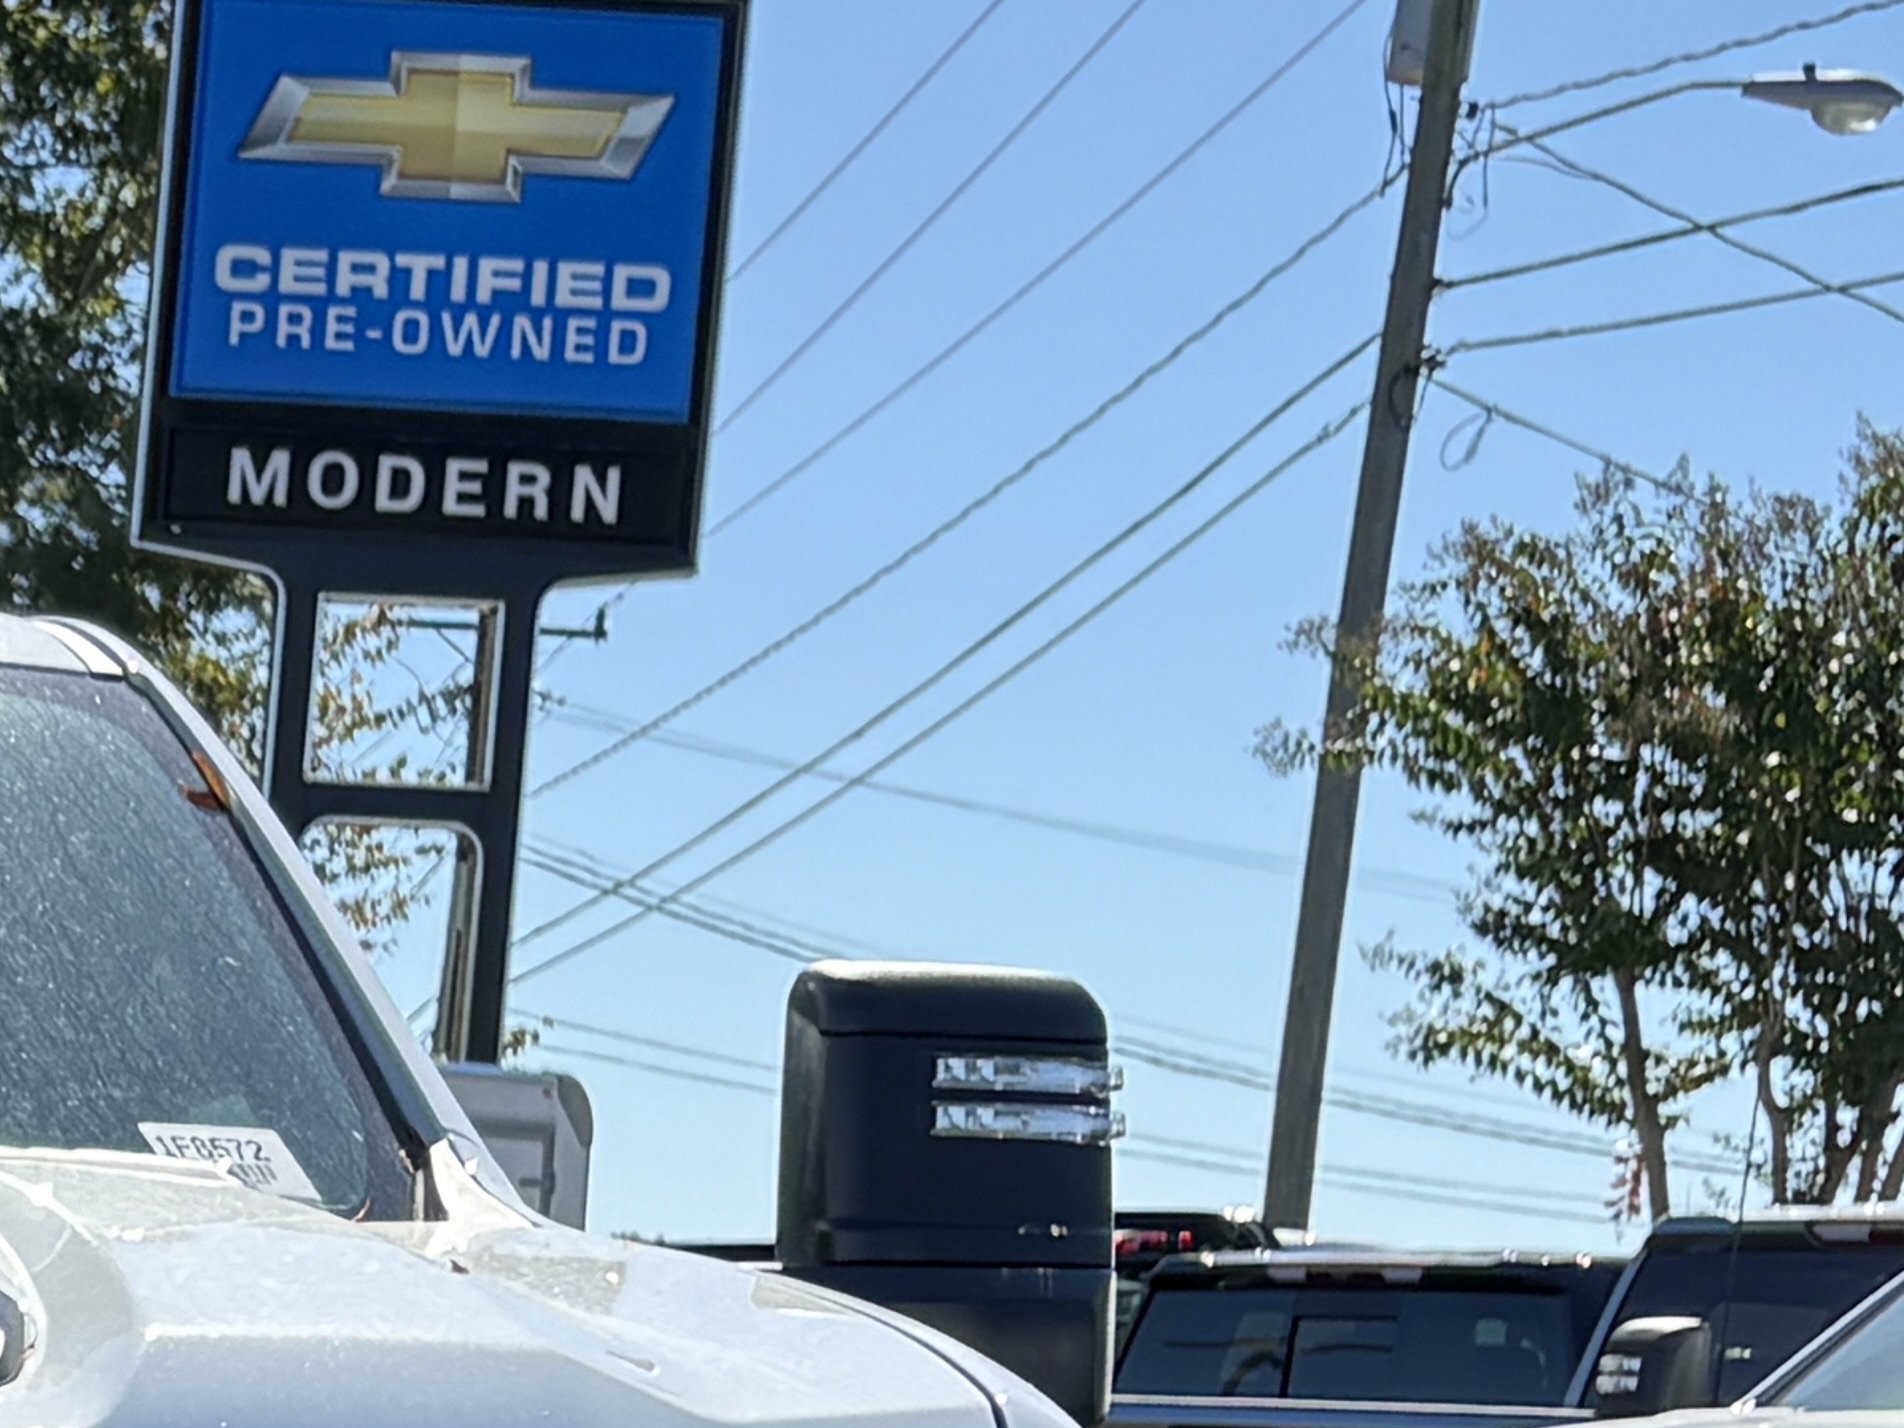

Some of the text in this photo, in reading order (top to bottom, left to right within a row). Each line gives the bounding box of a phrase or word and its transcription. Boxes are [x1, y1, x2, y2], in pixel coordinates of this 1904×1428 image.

[214, 245, 671, 313] CERTIFIED
[228, 302, 648, 366] PRE-OWNED
[226, 446, 622, 525] MODERN
